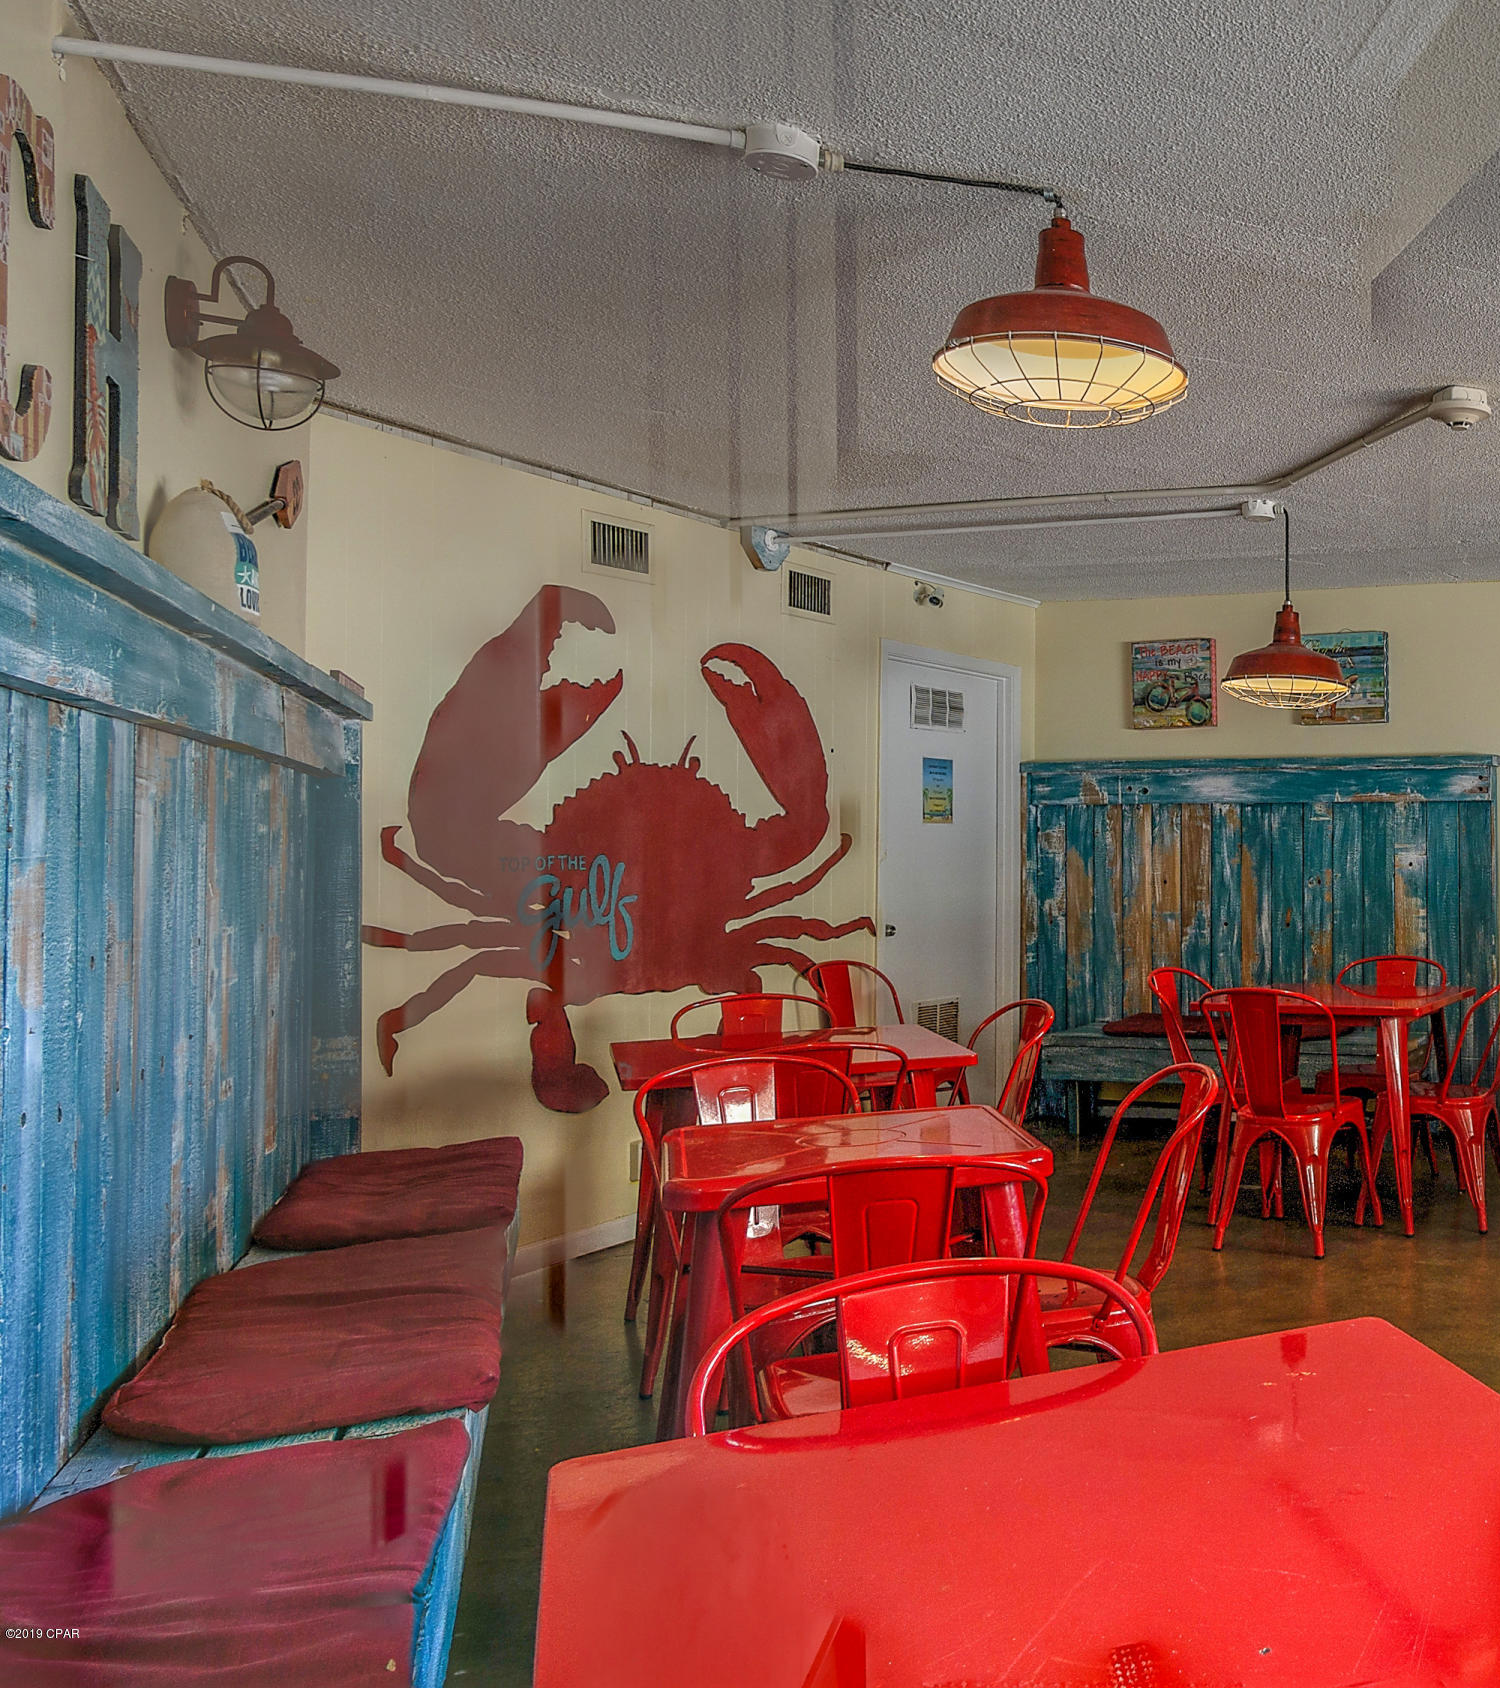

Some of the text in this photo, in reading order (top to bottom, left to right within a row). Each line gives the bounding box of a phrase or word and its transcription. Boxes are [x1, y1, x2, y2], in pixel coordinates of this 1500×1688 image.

[1139, 642, 1199, 657] The BEACH
[1155, 658, 1181, 669] is my
[1135, 670, 1168, 682] HAPPY
[499, 855, 586, 872] TOP OF THE
[517, 854, 639, 973] Gulf
